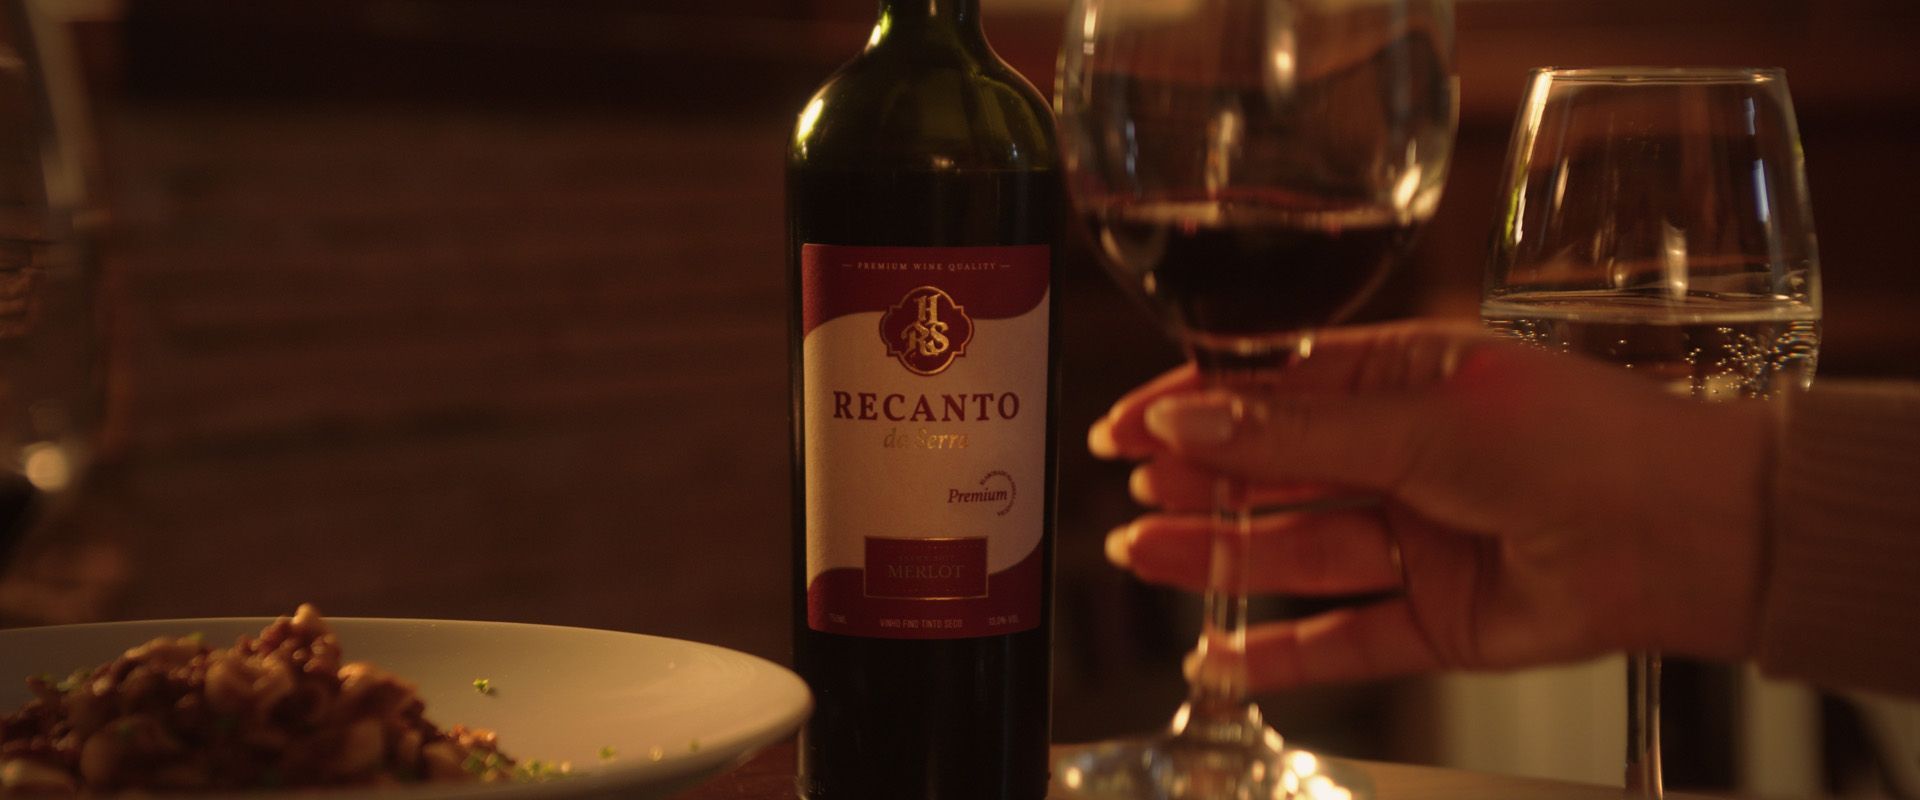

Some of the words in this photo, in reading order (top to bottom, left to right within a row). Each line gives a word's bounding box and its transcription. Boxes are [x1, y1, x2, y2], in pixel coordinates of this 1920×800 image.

[857, 261, 908, 271] PREMIUM
[912, 262, 943, 271] WINE
[948, 262, 996, 273] QUALITY
[831, 390, 1020, 421] RECANTO
[947, 487, 1008, 504] Premium
[887, 564, 964, 579] MERLOT
